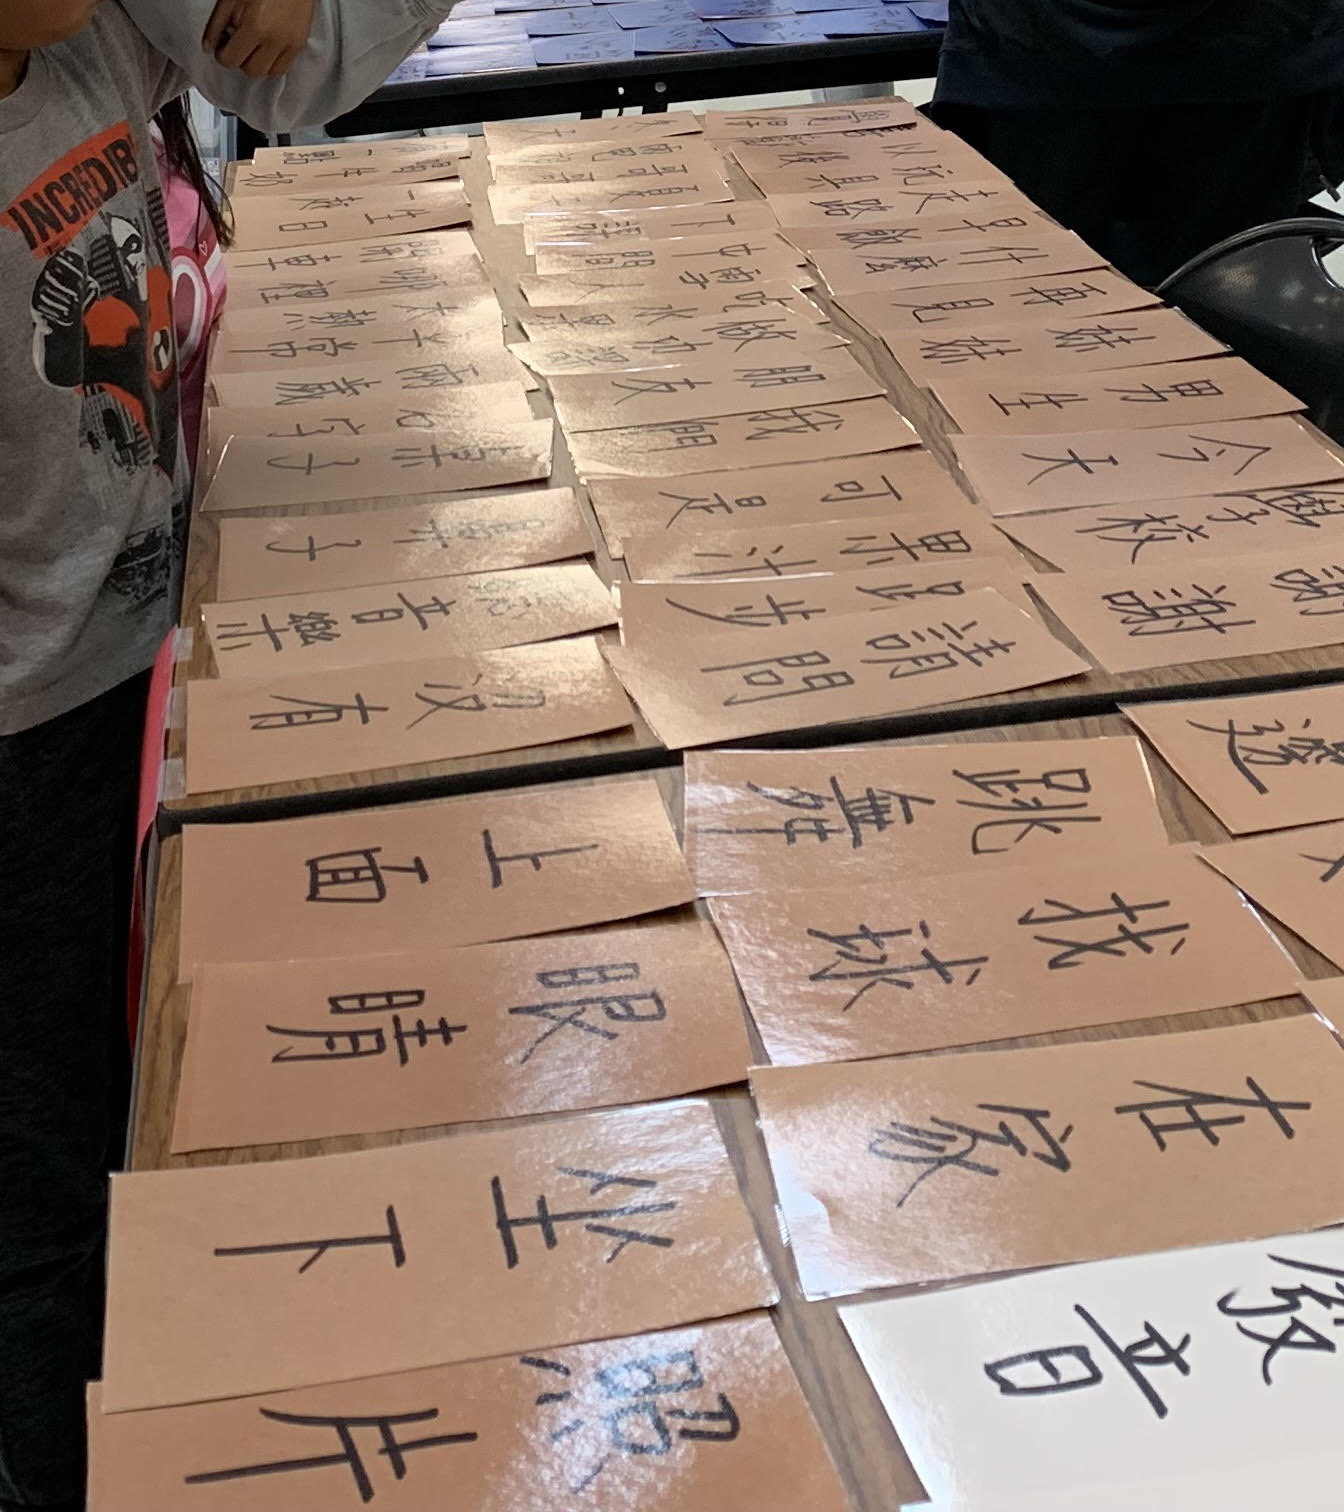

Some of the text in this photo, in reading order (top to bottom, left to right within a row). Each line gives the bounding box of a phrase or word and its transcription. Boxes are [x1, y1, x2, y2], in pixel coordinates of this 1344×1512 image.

[531, 164, 689, 183] 哥哥
[777, 141, 938, 169] 以後
[805, 163, 954, 190] 玩具
[288, 188, 415, 210] 一起
[809, 189, 999, 218] 走路
[278, 208, 431, 232] 生日
[835, 216, 1029, 250] 早飯
[233, 239, 444, 272] 開車
[570, 242, 767, 267] 中間
[856, 245, 1050, 275] 什麼
[258, 267, 449, 304] 哪裡
[568, 267, 762, 308] 雪人
[891, 282, 1109, 325] 再見
[283, 302, 459, 332] 太熱
[534, 292, 795, 330] 吃水果
[227, 328, 449, 358] 平常
[550, 318, 798, 365] 做功課
[919, 324, 1157, 365] 妹妹
[274, 363, 481, 407] 兩歲
[611, 364, 827, 406] 朋友
[988, 378, 1226, 418] 男生
[620, 407, 846, 454] 我們
[266, 443, 524, 476] 桌子
[1020, 434, 1274, 486] 今天
[657, 475, 903, 529] 可是
[675, 529, 973, 578] 果汁
[700, 620, 1017, 707] 請問
[249, 673, 547, 732] 沒有
[696, 768, 1103, 856] 跳舞
[304, 828, 600, 903] 上面
[806, 892, 1190, 1012] 找球
[266, 962, 667, 1067] 眼睛
[867, 1075, 1312, 1208] 在家
[213, 1165, 676, 1275] 坐下
[184, 1350, 740, 1503] 照片
